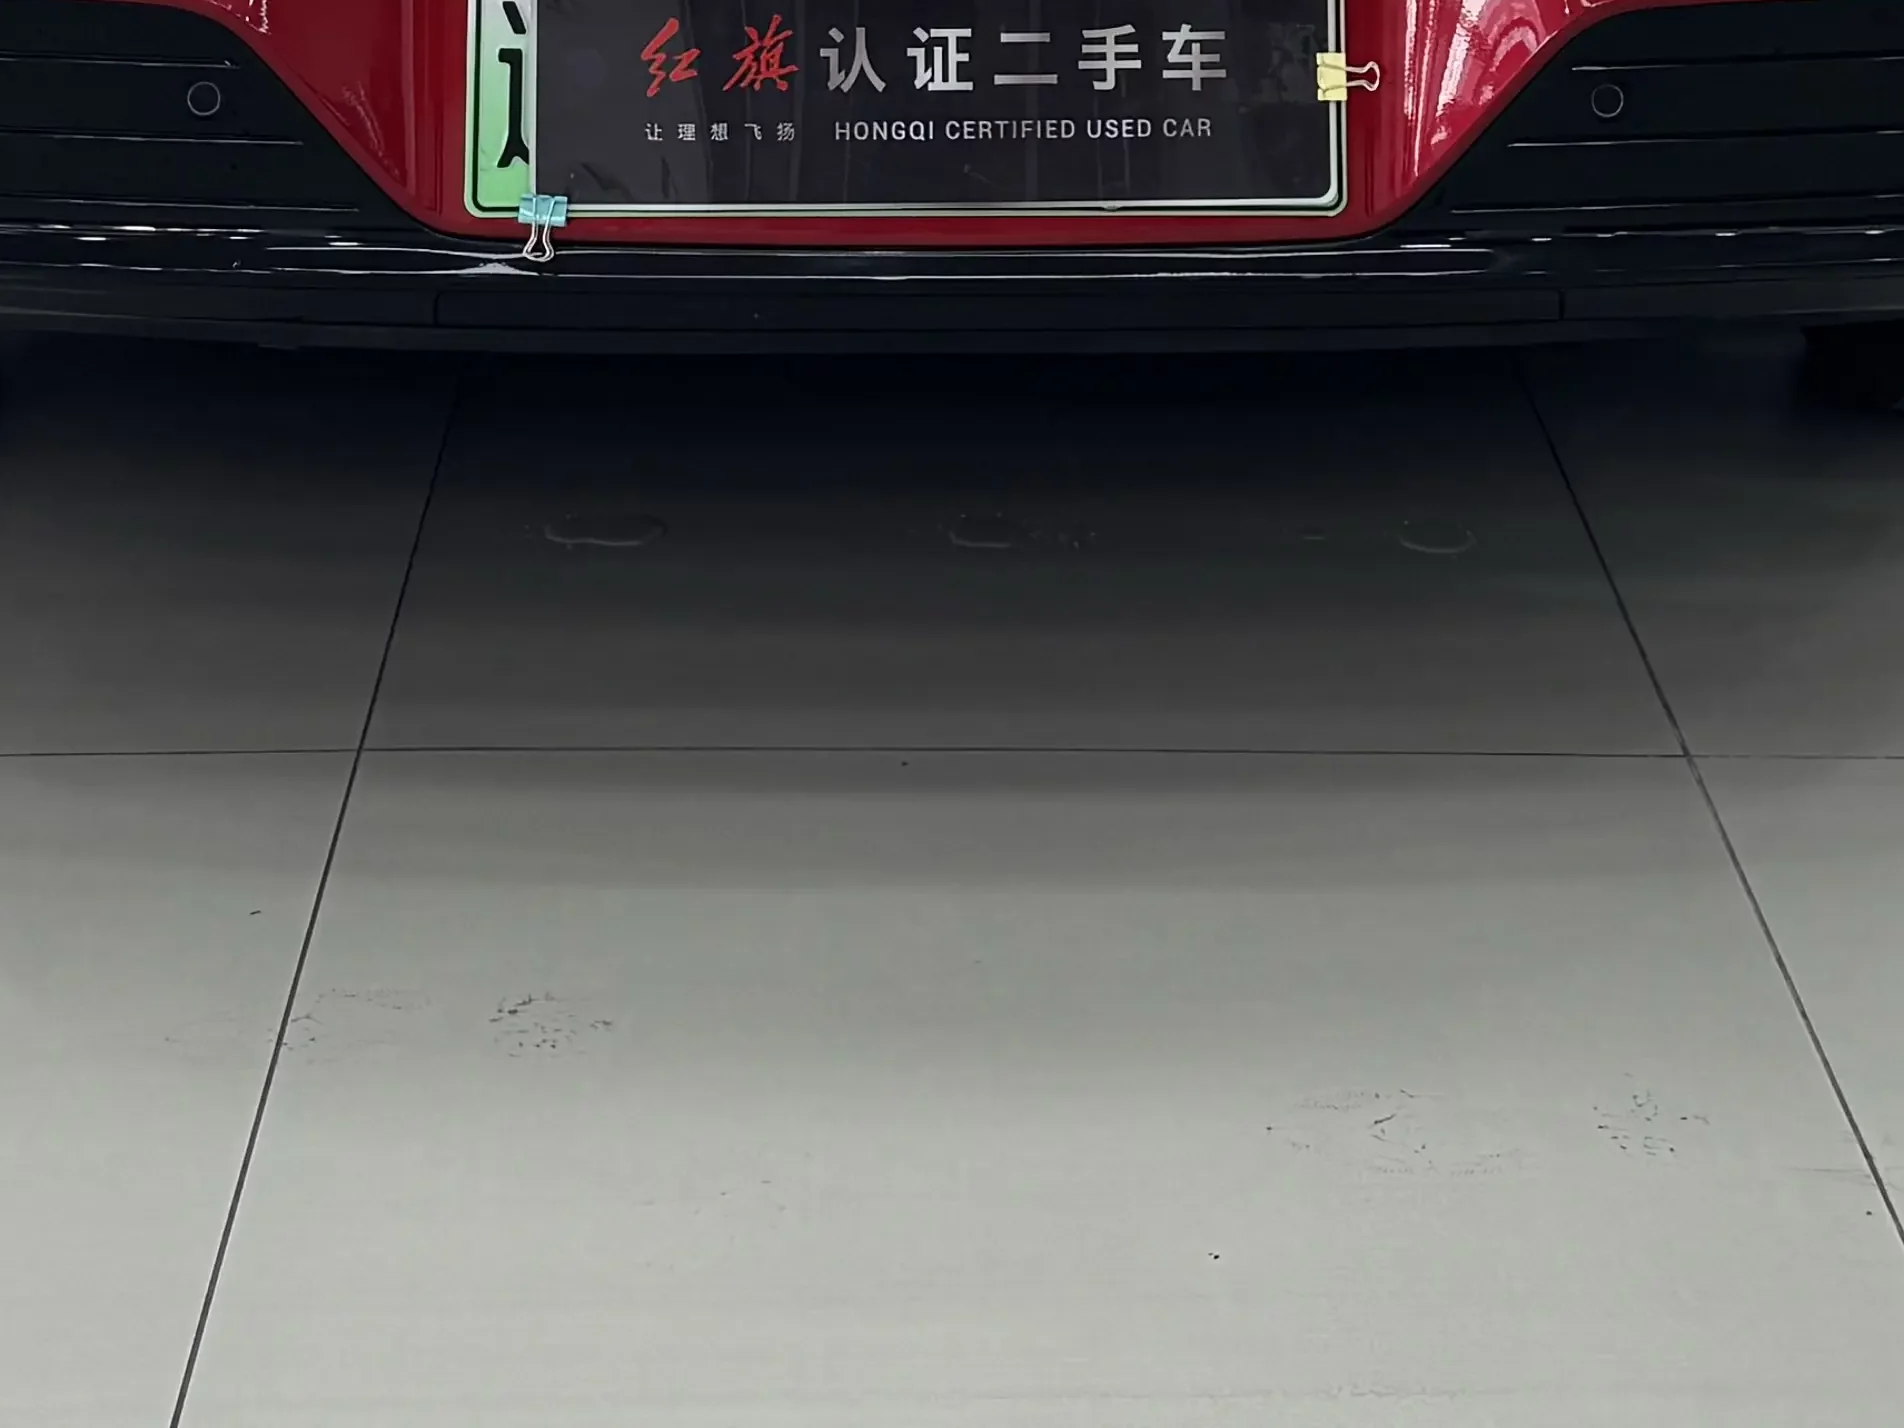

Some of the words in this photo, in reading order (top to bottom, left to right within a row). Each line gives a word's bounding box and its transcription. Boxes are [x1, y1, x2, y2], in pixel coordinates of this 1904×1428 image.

[644, 122, 796, 141] 让理想飞扬
[835, 120, 935, 142] HONGQI
[945, 119, 1076, 140] CERTIFIED
[1086, 118, 1152, 139] USED
[1162, 118, 1212, 138] CAR
